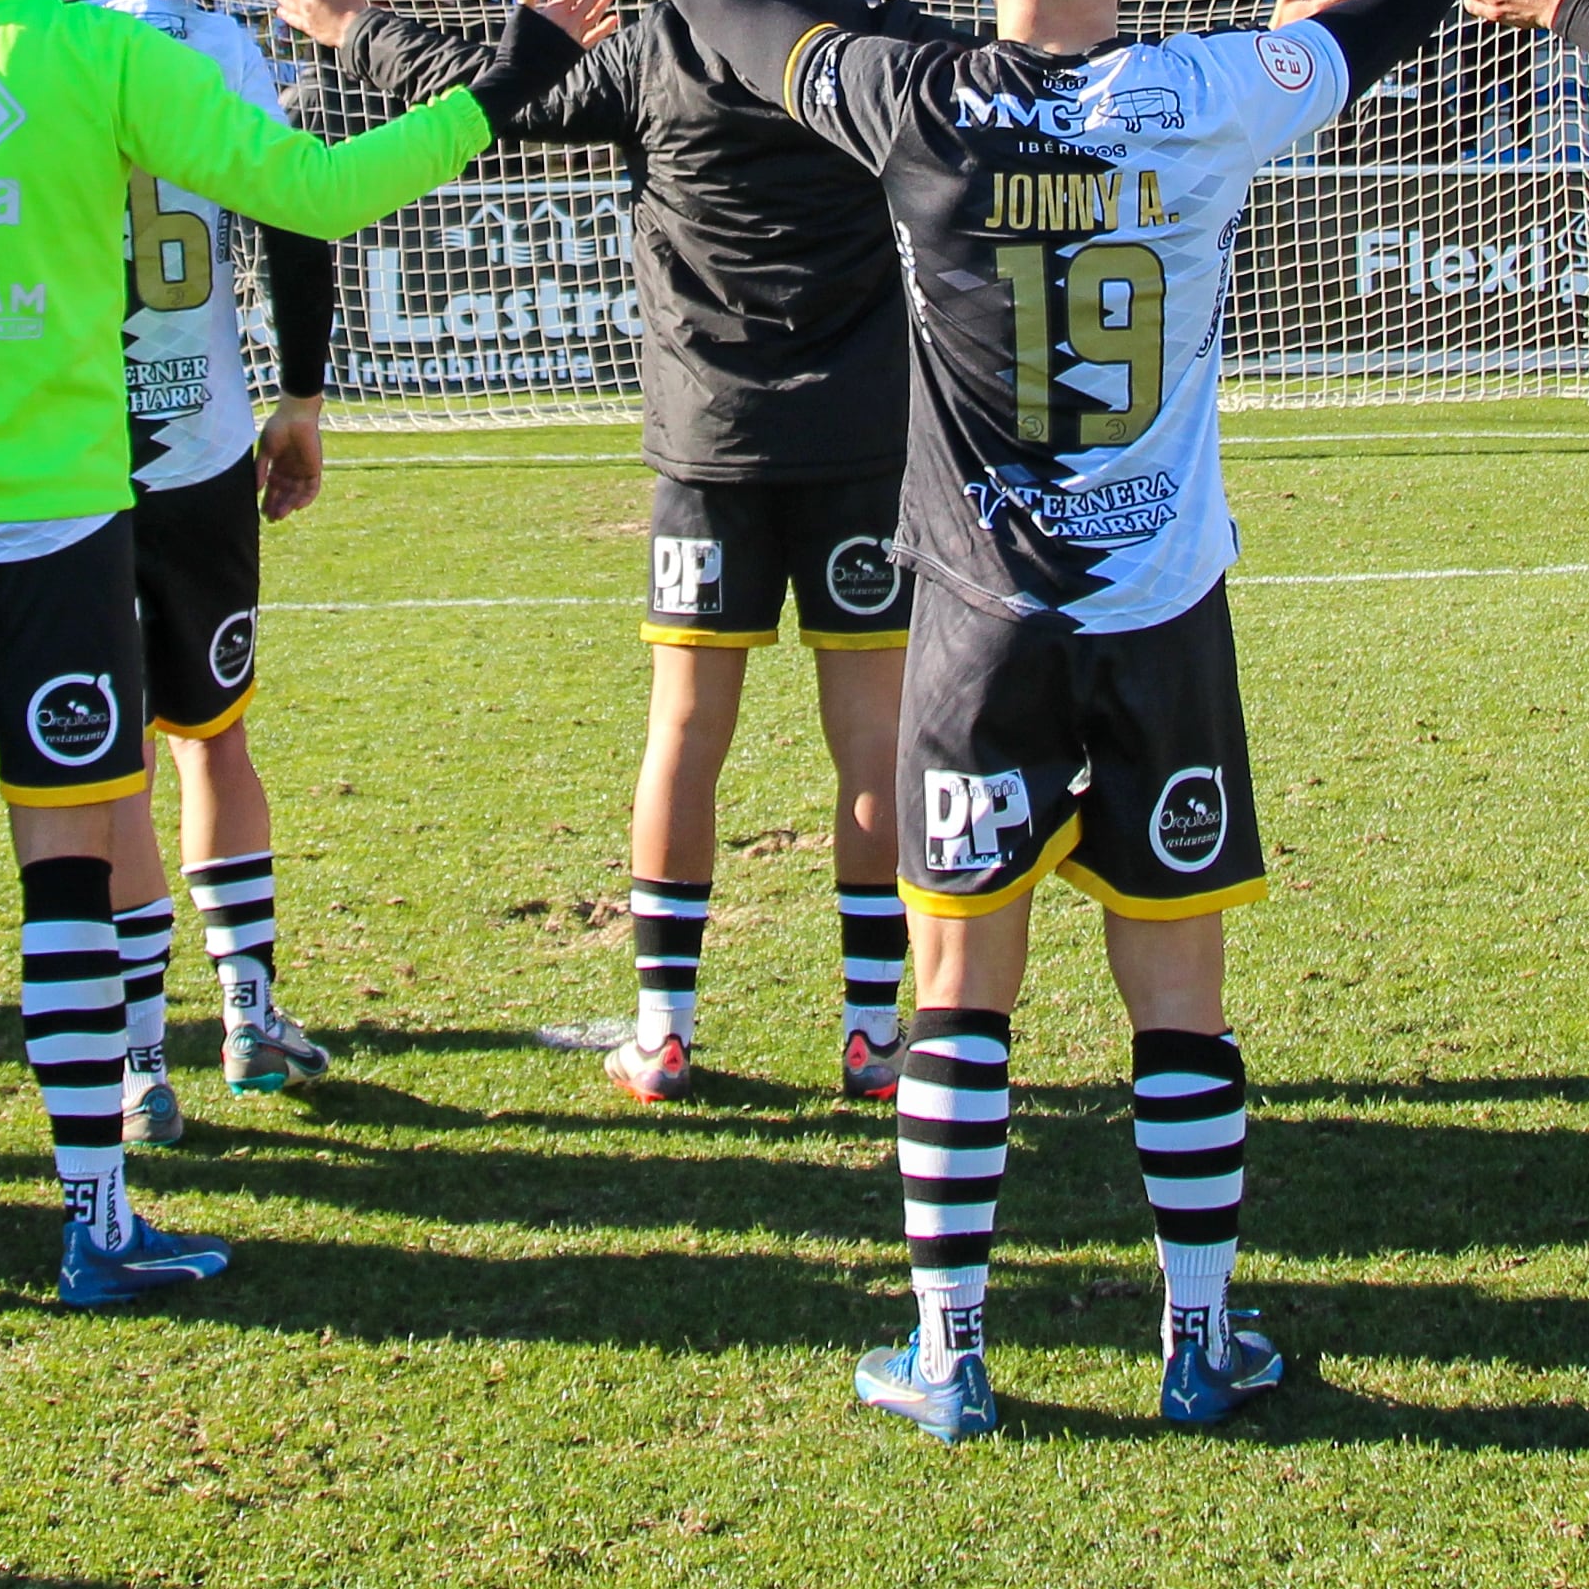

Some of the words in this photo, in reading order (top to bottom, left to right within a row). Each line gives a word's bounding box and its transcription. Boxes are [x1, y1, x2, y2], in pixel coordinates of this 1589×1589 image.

[1018, 141, 1127, 158] IBÉRICOS
[985, 172, 1123, 232] JONNY
[1138, 170, 1180, 230] A.
[994, 241, 1167, 446] 19
[1014, 472, 1179, 519] TERNERA
